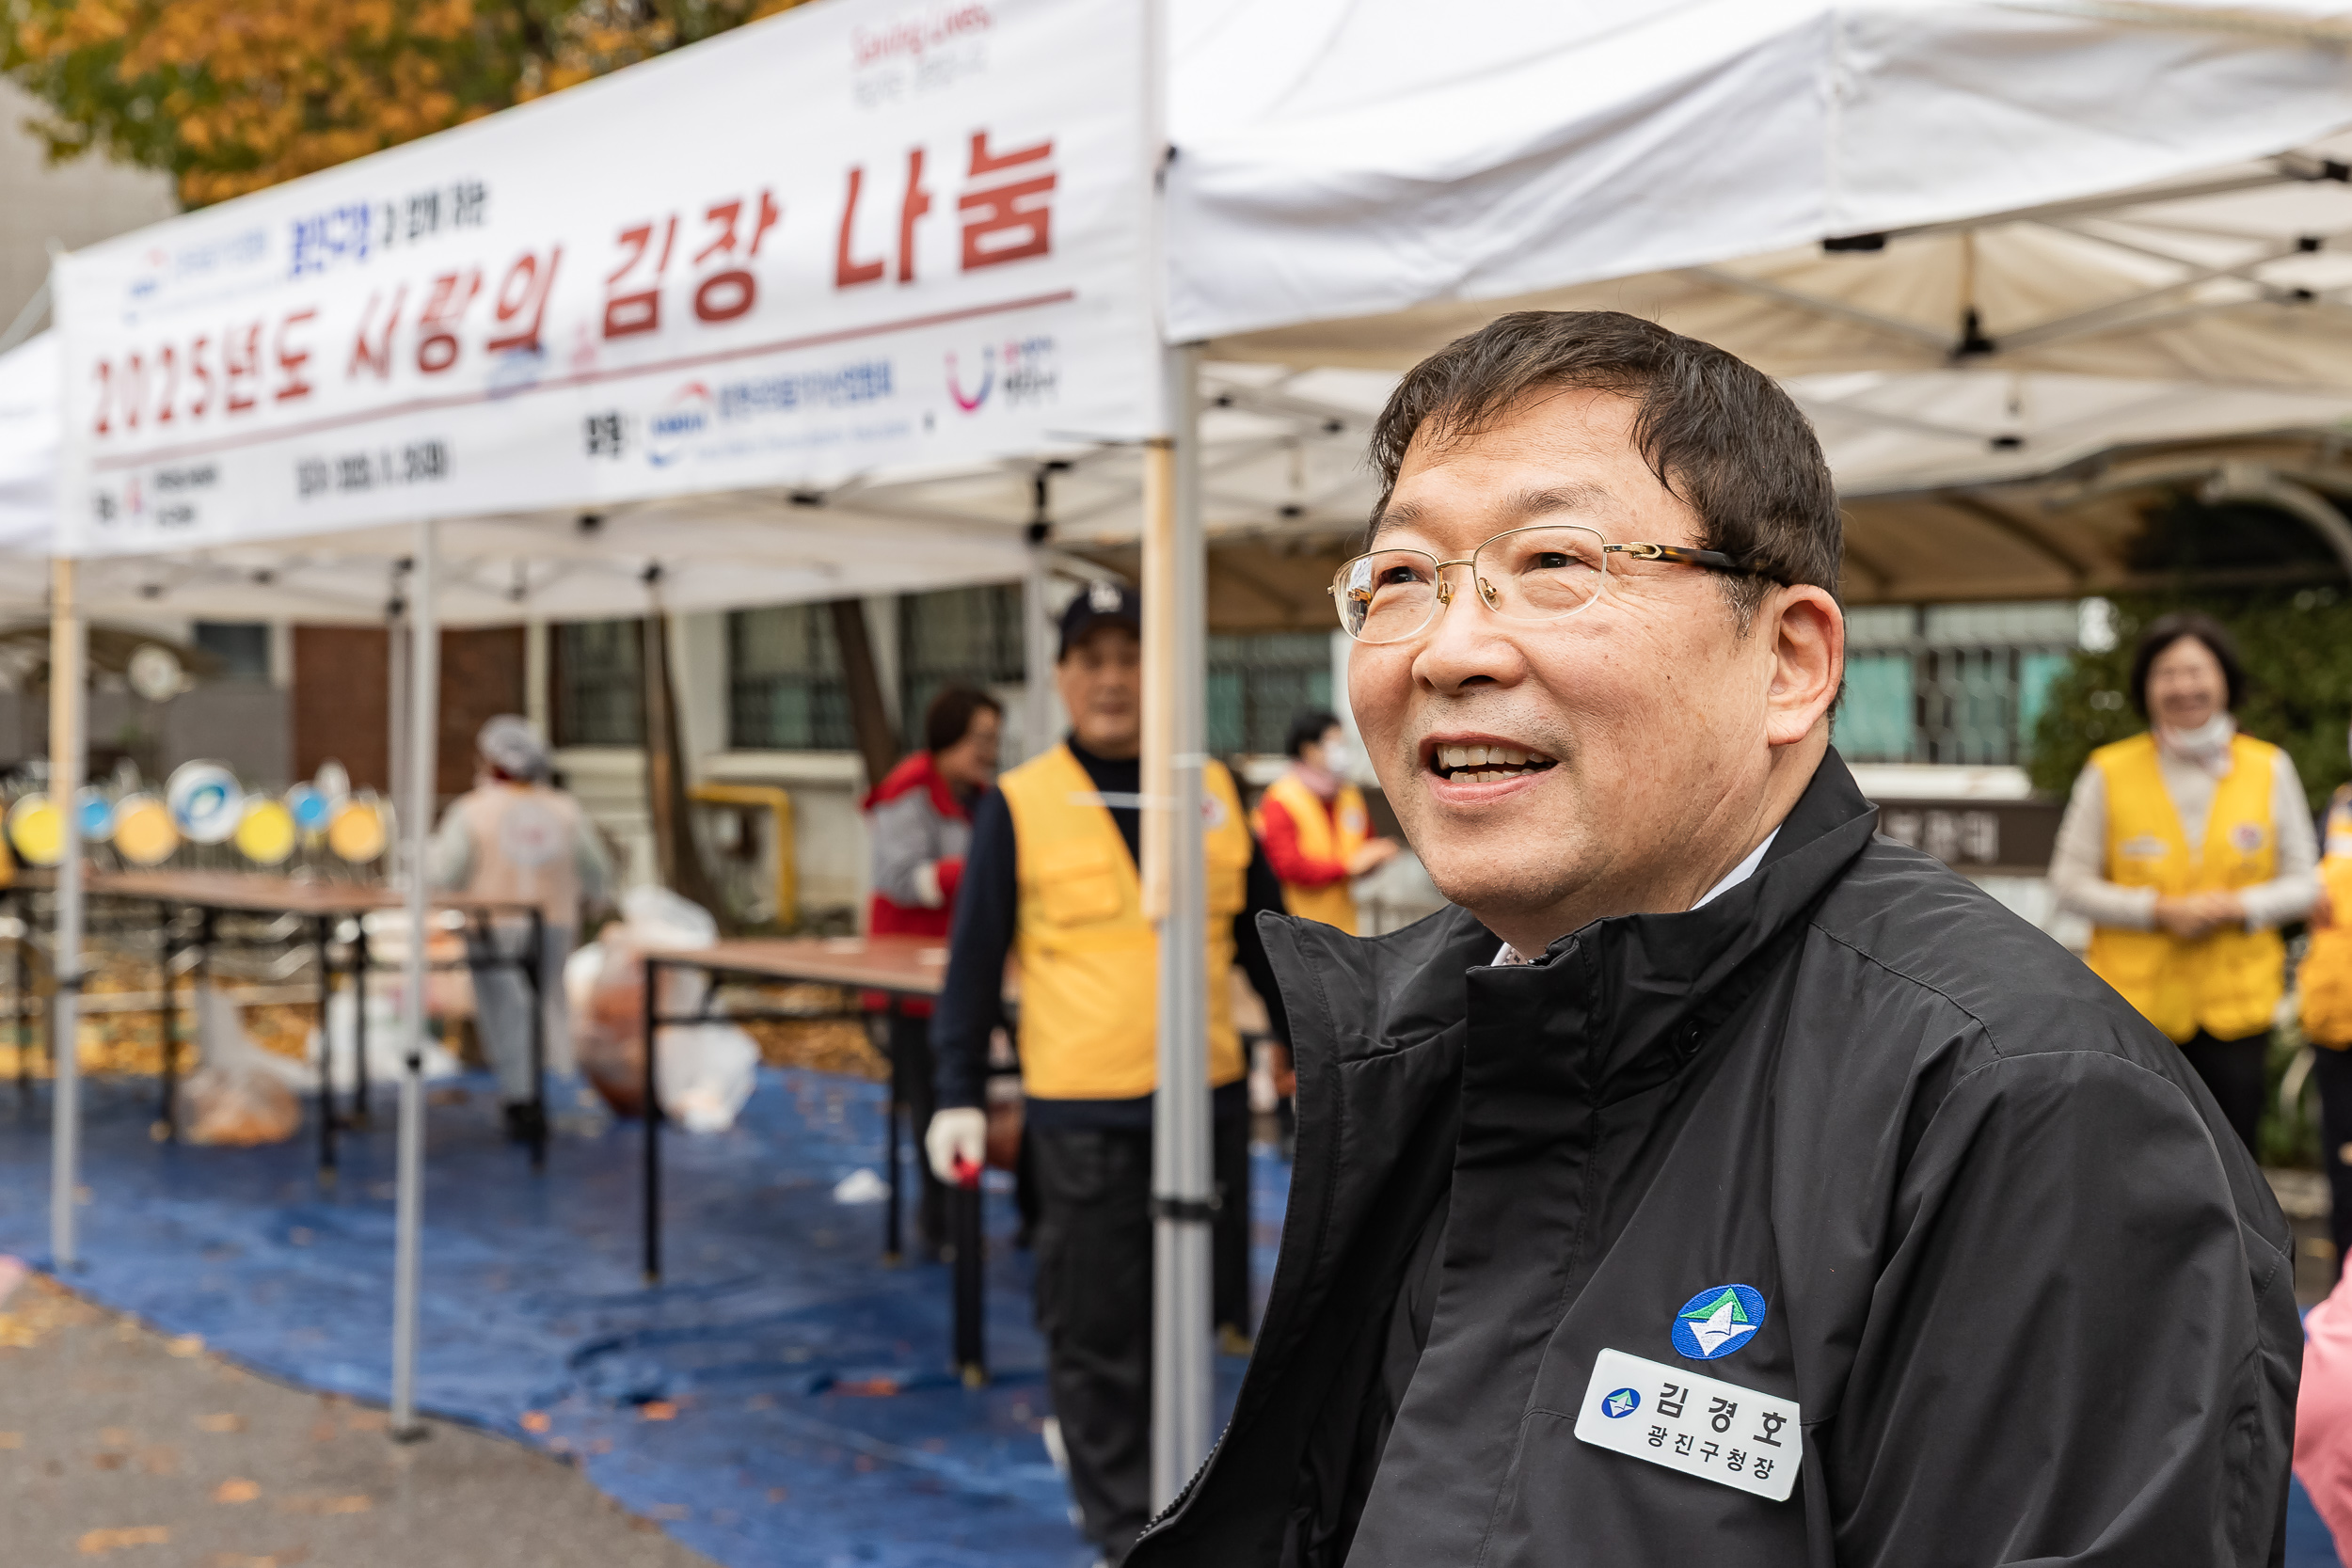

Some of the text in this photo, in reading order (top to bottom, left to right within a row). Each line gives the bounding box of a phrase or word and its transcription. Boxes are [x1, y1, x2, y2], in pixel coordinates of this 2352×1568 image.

[94, 130, 1058, 436] 2025년도 사랑의 김장 나눔
[1647, 1425, 1775, 1480] 광진구청장
